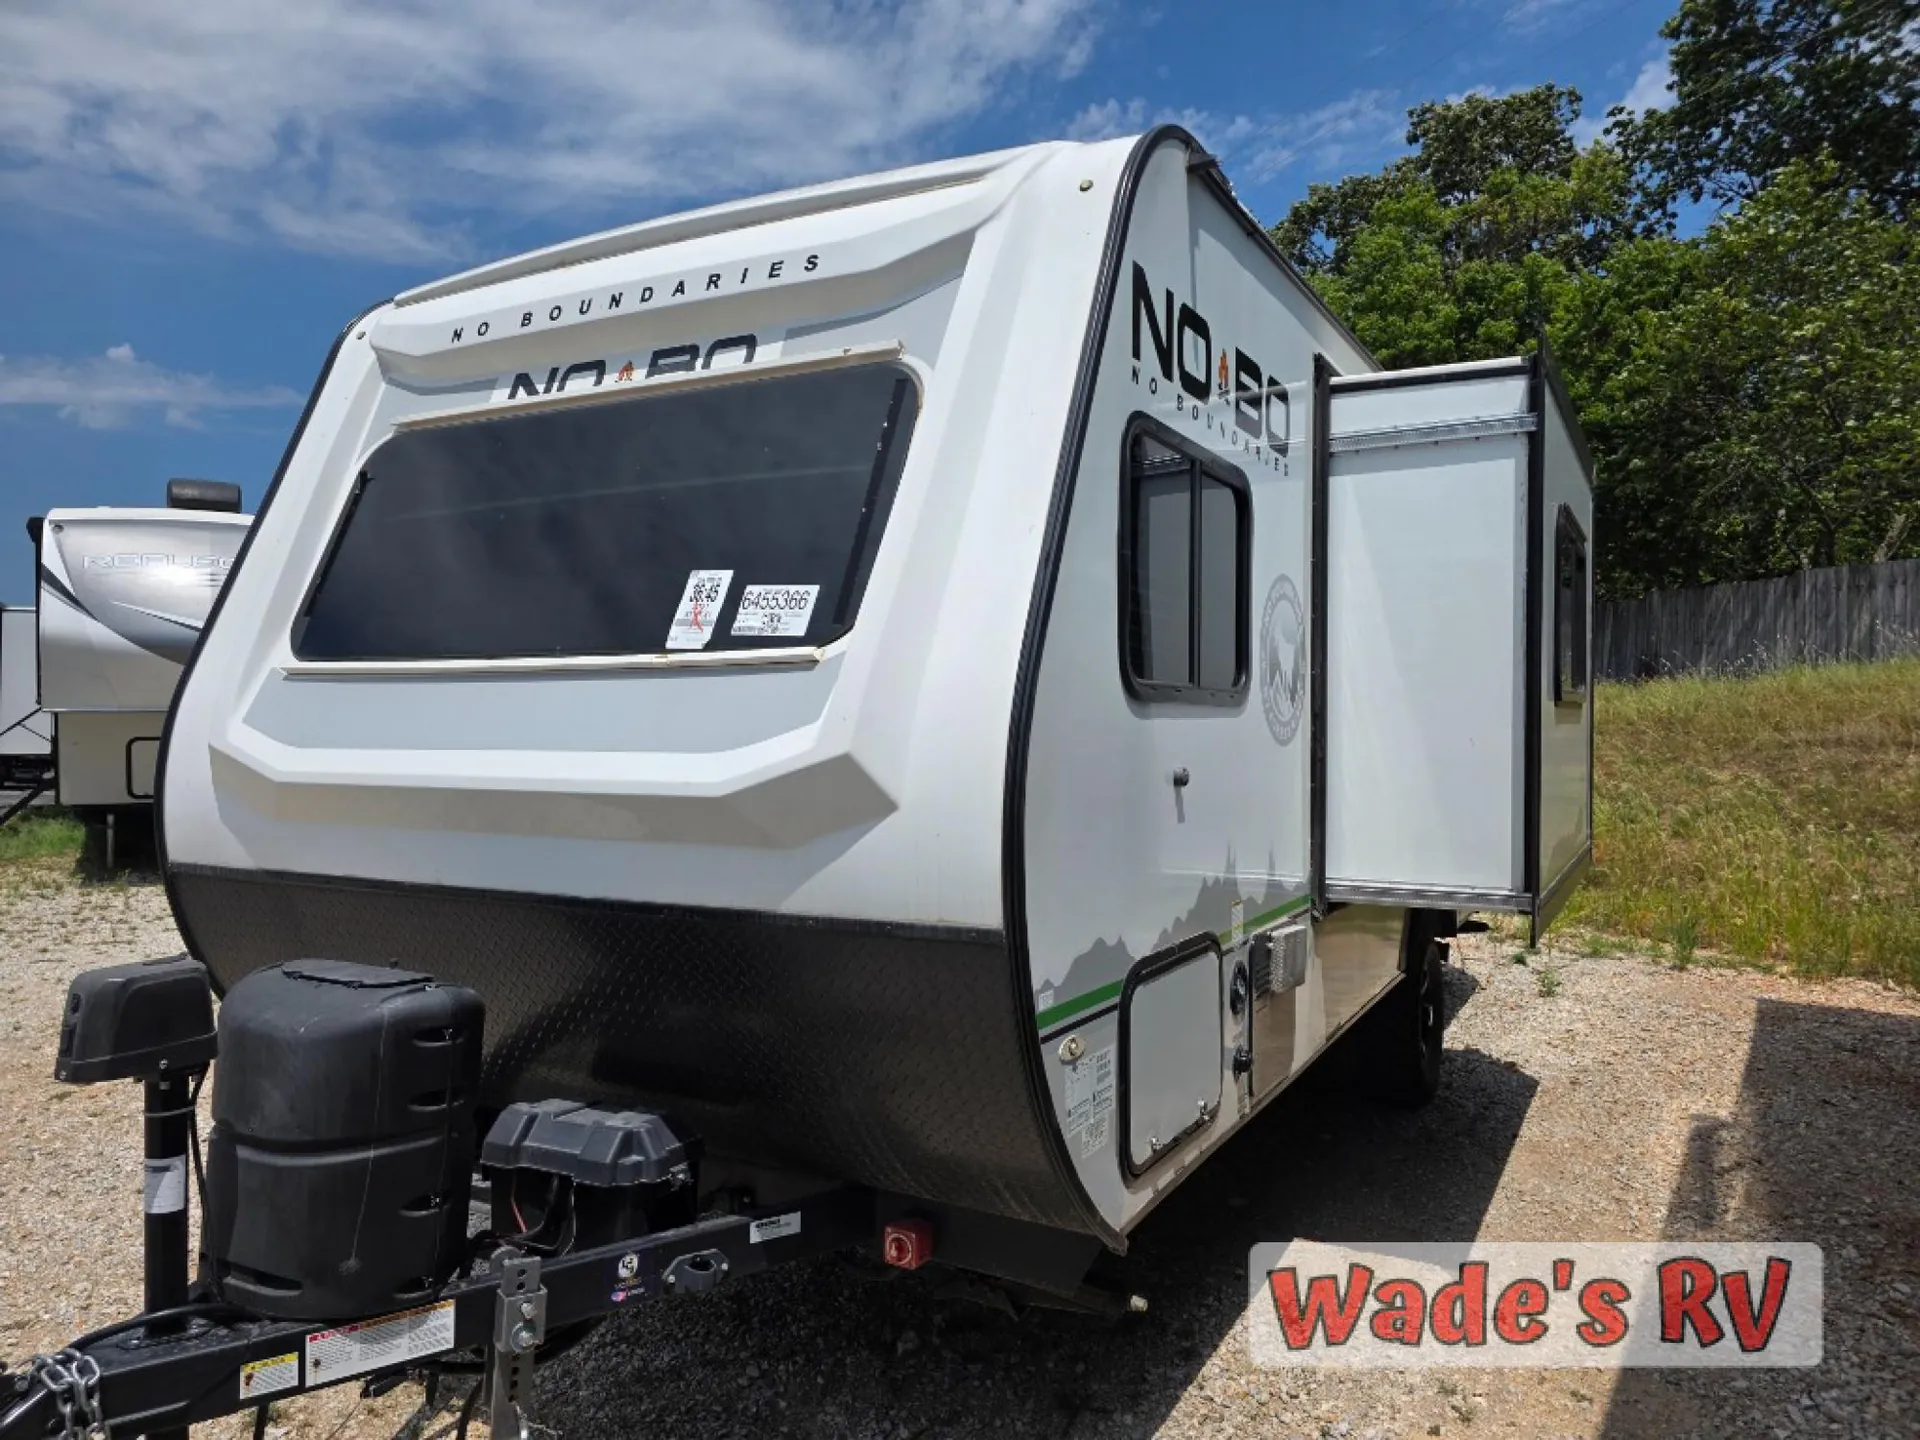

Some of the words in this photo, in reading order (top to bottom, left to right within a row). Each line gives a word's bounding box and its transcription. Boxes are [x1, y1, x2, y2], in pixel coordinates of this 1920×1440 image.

[451, 320, 490, 344] NO
[520, 254, 820, 328] BOUNDARIES
[1131, 260, 1213, 405] NO
[1131, 364, 1158, 396] NO
[741, 590, 811, 611] 6455366
